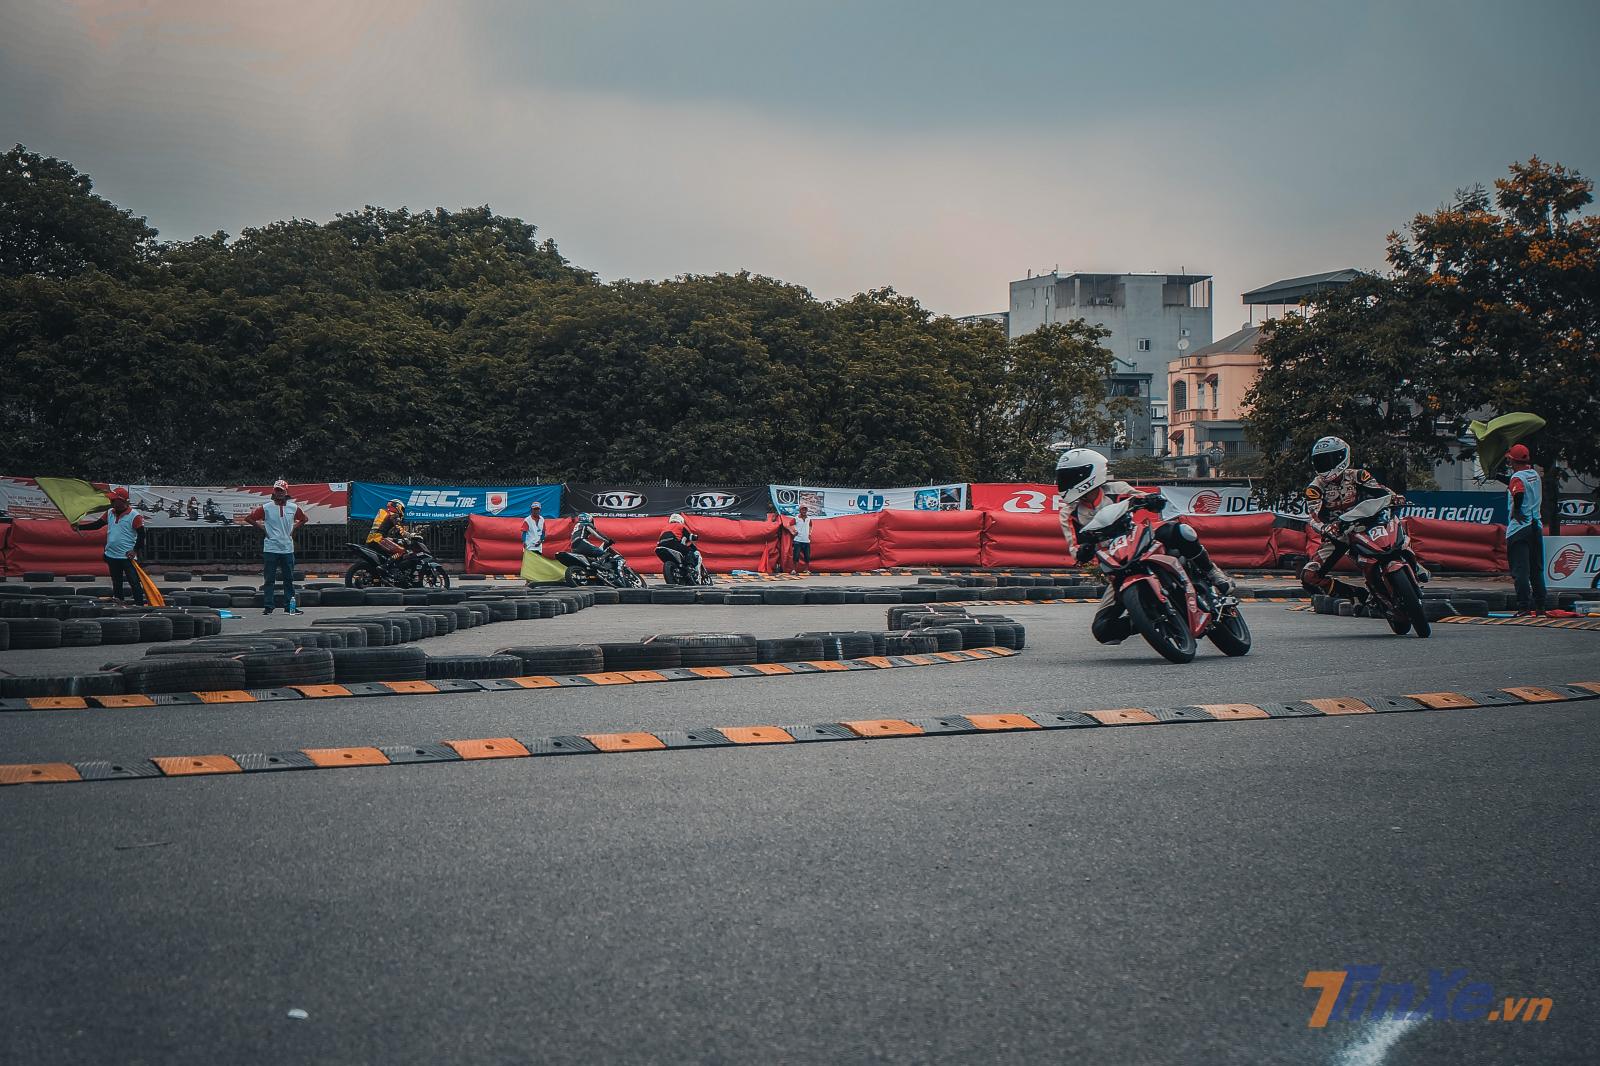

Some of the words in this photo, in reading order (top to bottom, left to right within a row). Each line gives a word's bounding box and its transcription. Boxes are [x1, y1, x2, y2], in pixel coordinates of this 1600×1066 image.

[407, 490, 460, 507] IRC
[456, 497, 477, 508] TIRE
[597, 495, 640, 507] KYT
[692, 495, 735, 508] KYT
[1226, 496, 1310, 515] IDEIS
[1438, 504, 1495, 525] racing
